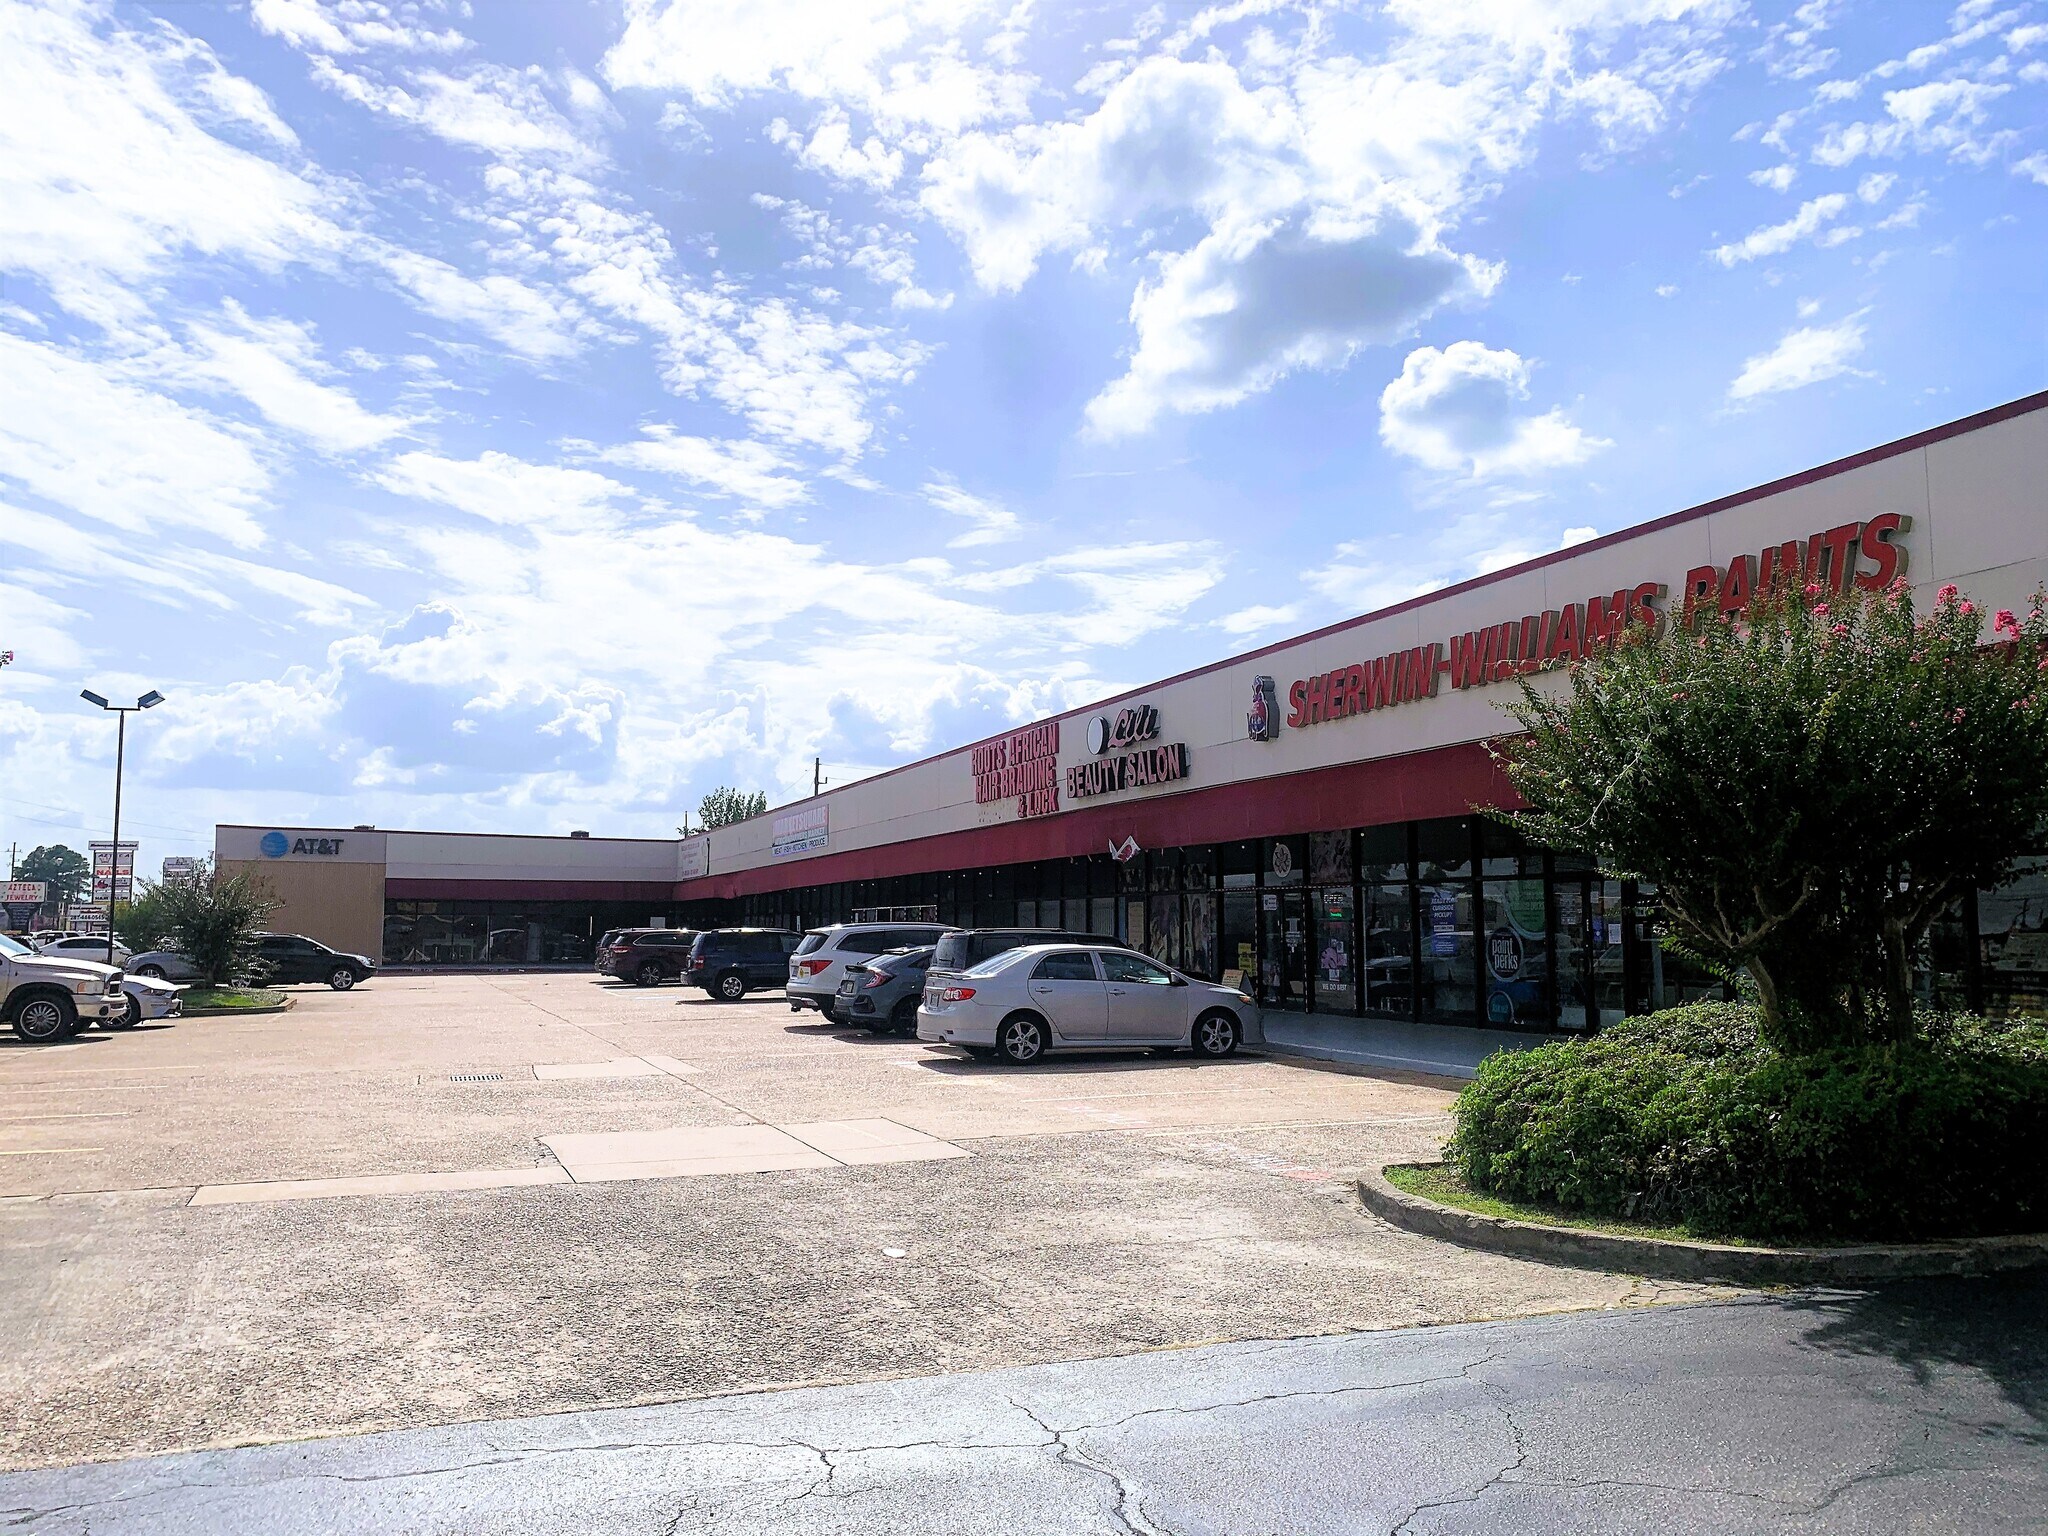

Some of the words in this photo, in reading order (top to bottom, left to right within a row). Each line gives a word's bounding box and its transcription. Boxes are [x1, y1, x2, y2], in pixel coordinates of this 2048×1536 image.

[1287, 583, 1668, 728] SHERWIN-WILLIAMS
[1683, 512, 1912, 633] PAINTS
[1009, 722, 1059, 766] AFRICAN
[975, 770, 1001, 804] HAIR
[1001, 756, 1057, 798] BRAIDING
[1067, 757, 1126, 798] BEAUTY
[1127, 743, 1187, 787] SALON
[1017, 794, 1027, 818] &
[1028, 787, 1059, 816] LOCK
[292, 838, 344, 855] AT&T
[8, 883, 36, 891] AZTECA
[1491, 937, 1514, 954] paint
[1494, 952, 1518, 970] perks
